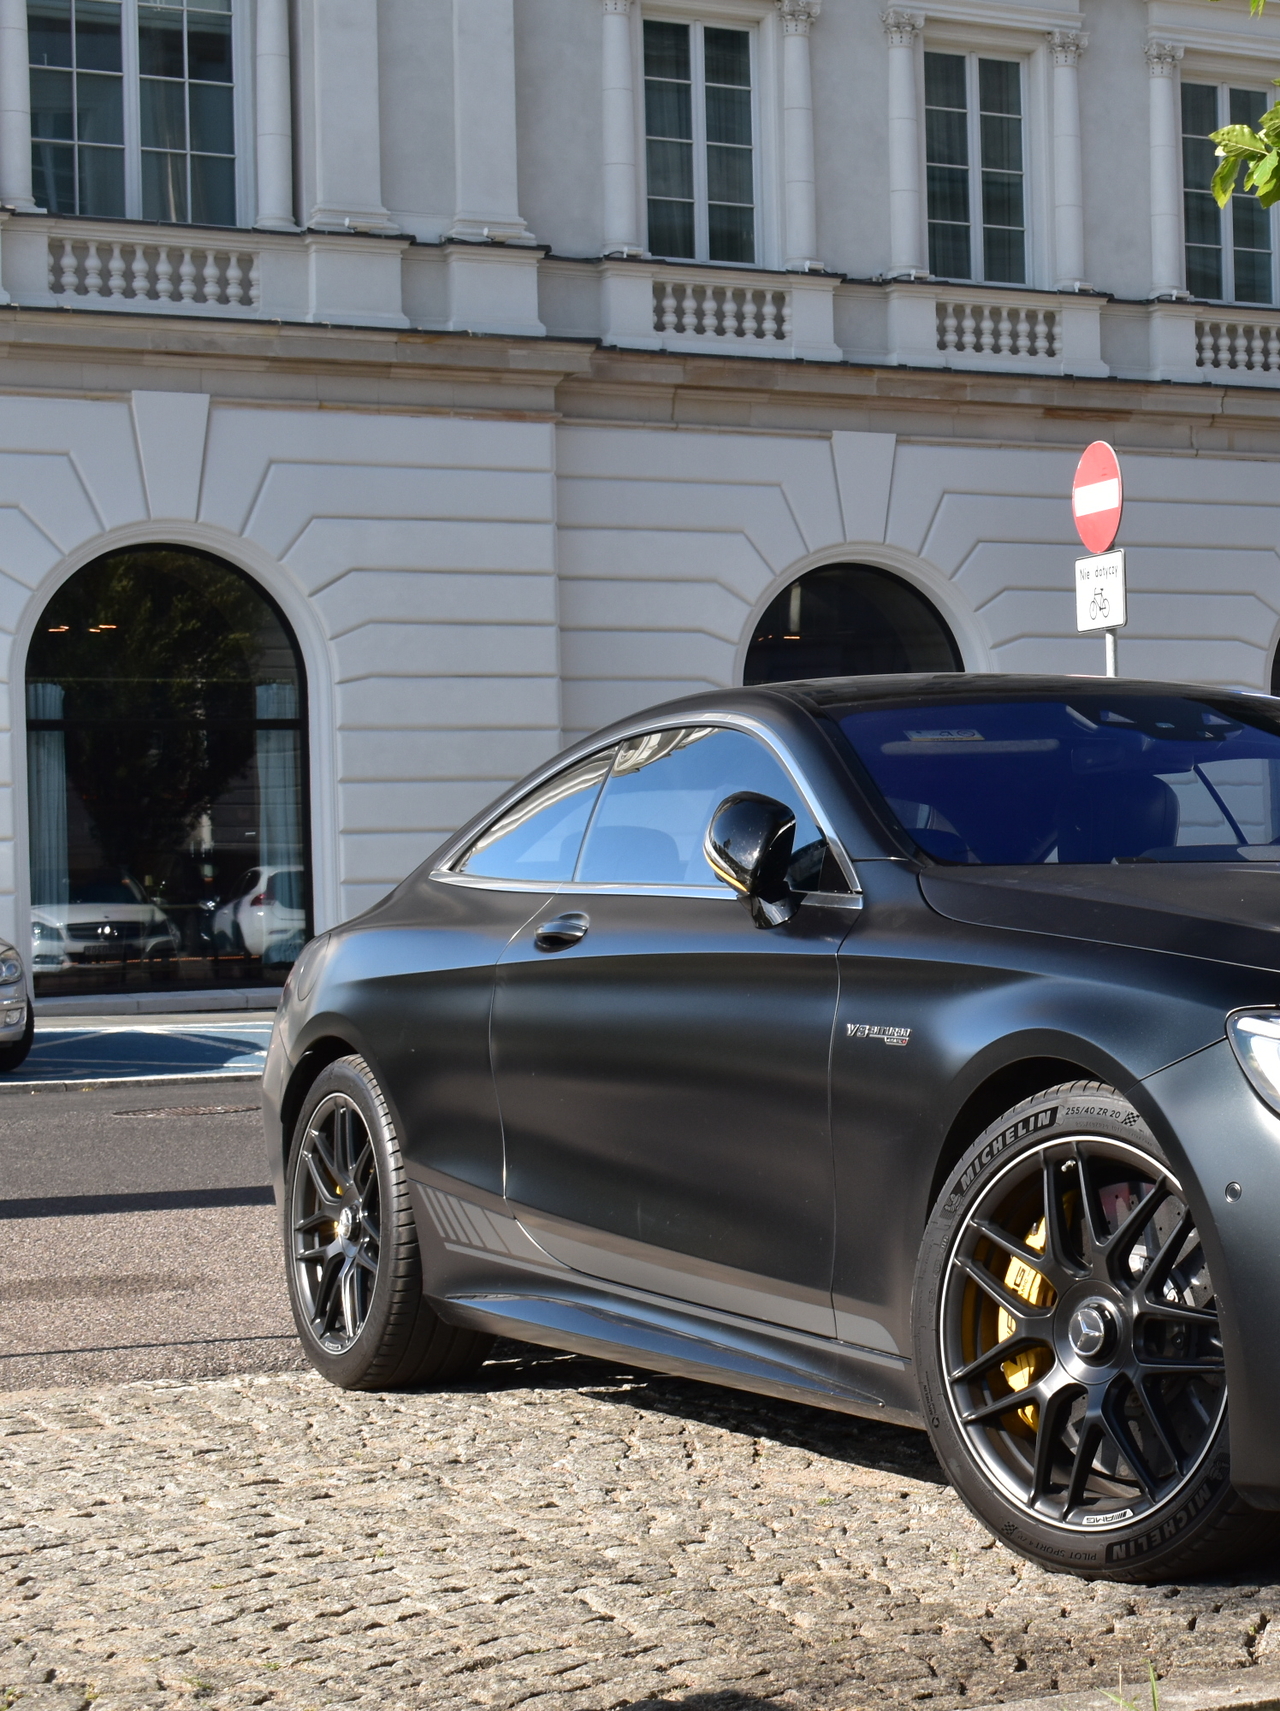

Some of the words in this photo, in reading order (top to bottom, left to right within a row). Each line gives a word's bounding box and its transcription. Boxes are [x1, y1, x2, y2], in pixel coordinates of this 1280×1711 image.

[1080, 568, 1091, 580] Nie
[1095, 565, 1119, 579] dotyczy
[960, 1110, 1052, 1191] MICHELIN
[1065, 1106, 1096, 1116] 255/40
[1097, 1107, 1109, 1116] ZR
[1110, 1110, 1121, 1119] 20
[1112, 1482, 1212, 1561] MICHELIN
[1034, 1541, 1066, 1557] SPORT
[1069, 1551, 1097, 1561] PILOT
